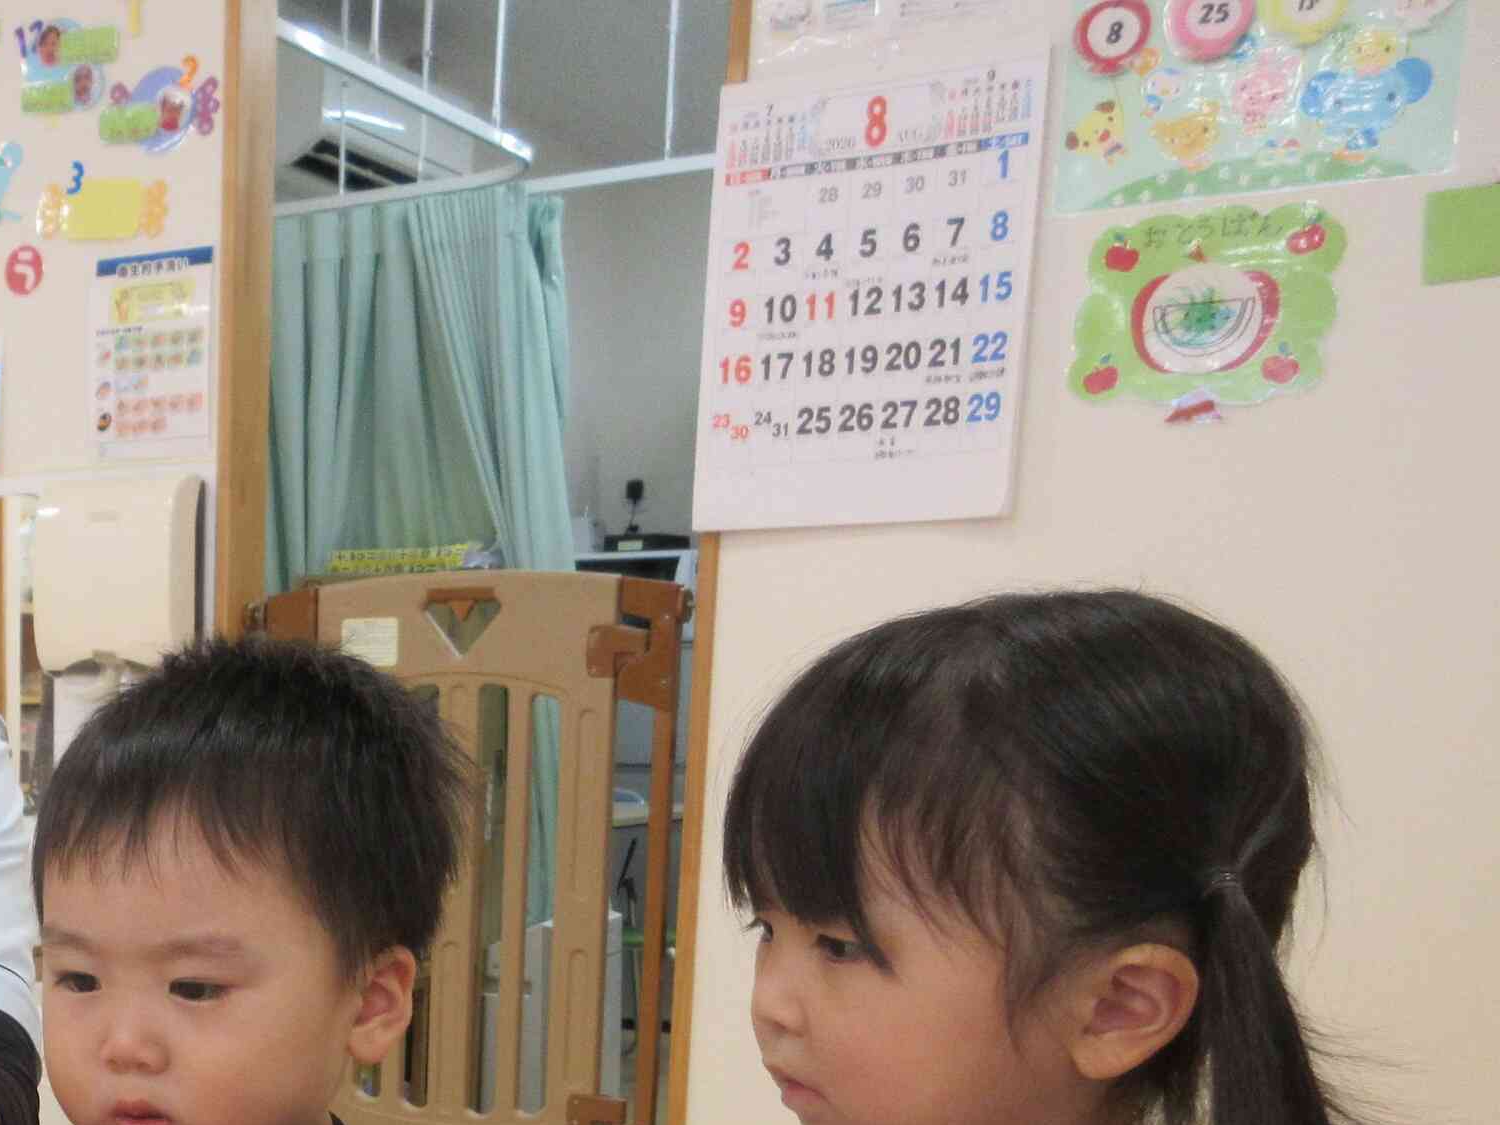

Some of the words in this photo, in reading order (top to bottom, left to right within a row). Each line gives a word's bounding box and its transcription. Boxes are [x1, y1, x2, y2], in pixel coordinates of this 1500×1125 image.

[1106, 22, 1124, 44] 8
[1199, 3, 1230, 24] 25
[180, 55, 198, 91] 2
[866, 96, 887, 148] 8
[66, 160, 85, 195] 3
[819, 186, 838, 203] 28
[862, 181, 882, 199] 29
[906, 176, 925, 194] 30
[948, 170, 966, 187] 31
[997, 150, 1010, 179] 1
[733, 242, 750, 271] 2
[775, 237, 790, 265] 3
[816, 233, 833, 261] 4
[860, 229, 876, 257] 5
[903, 223, 920, 252] 6
[947, 217, 964, 246] 7
[990, 211, 1008, 241] 8
[730, 299, 746, 327] 9
[765, 295, 796, 323] 10
[807, 291, 835, 320] 11
[850, 286, 883, 316] 12
[893, 282, 925, 312] 13
[936, 277, 969, 307] 14
[980, 271, 1012, 302] 15
[720, 355, 752, 384] 16
[762, 352, 793, 380] 17
[803, 349, 835, 377] 18
[845, 345, 878, 374] 19
[885, 341, 921, 371] 20
[928, 338, 960, 367] 21
[972, 331, 1007, 363] 22
[796, 406, 831, 435] 25
[838, 403, 873, 432] 26
[881, 400, 917, 429] 27
[924, 396, 960, 426] 28
[966, 392, 1000, 422] 29
